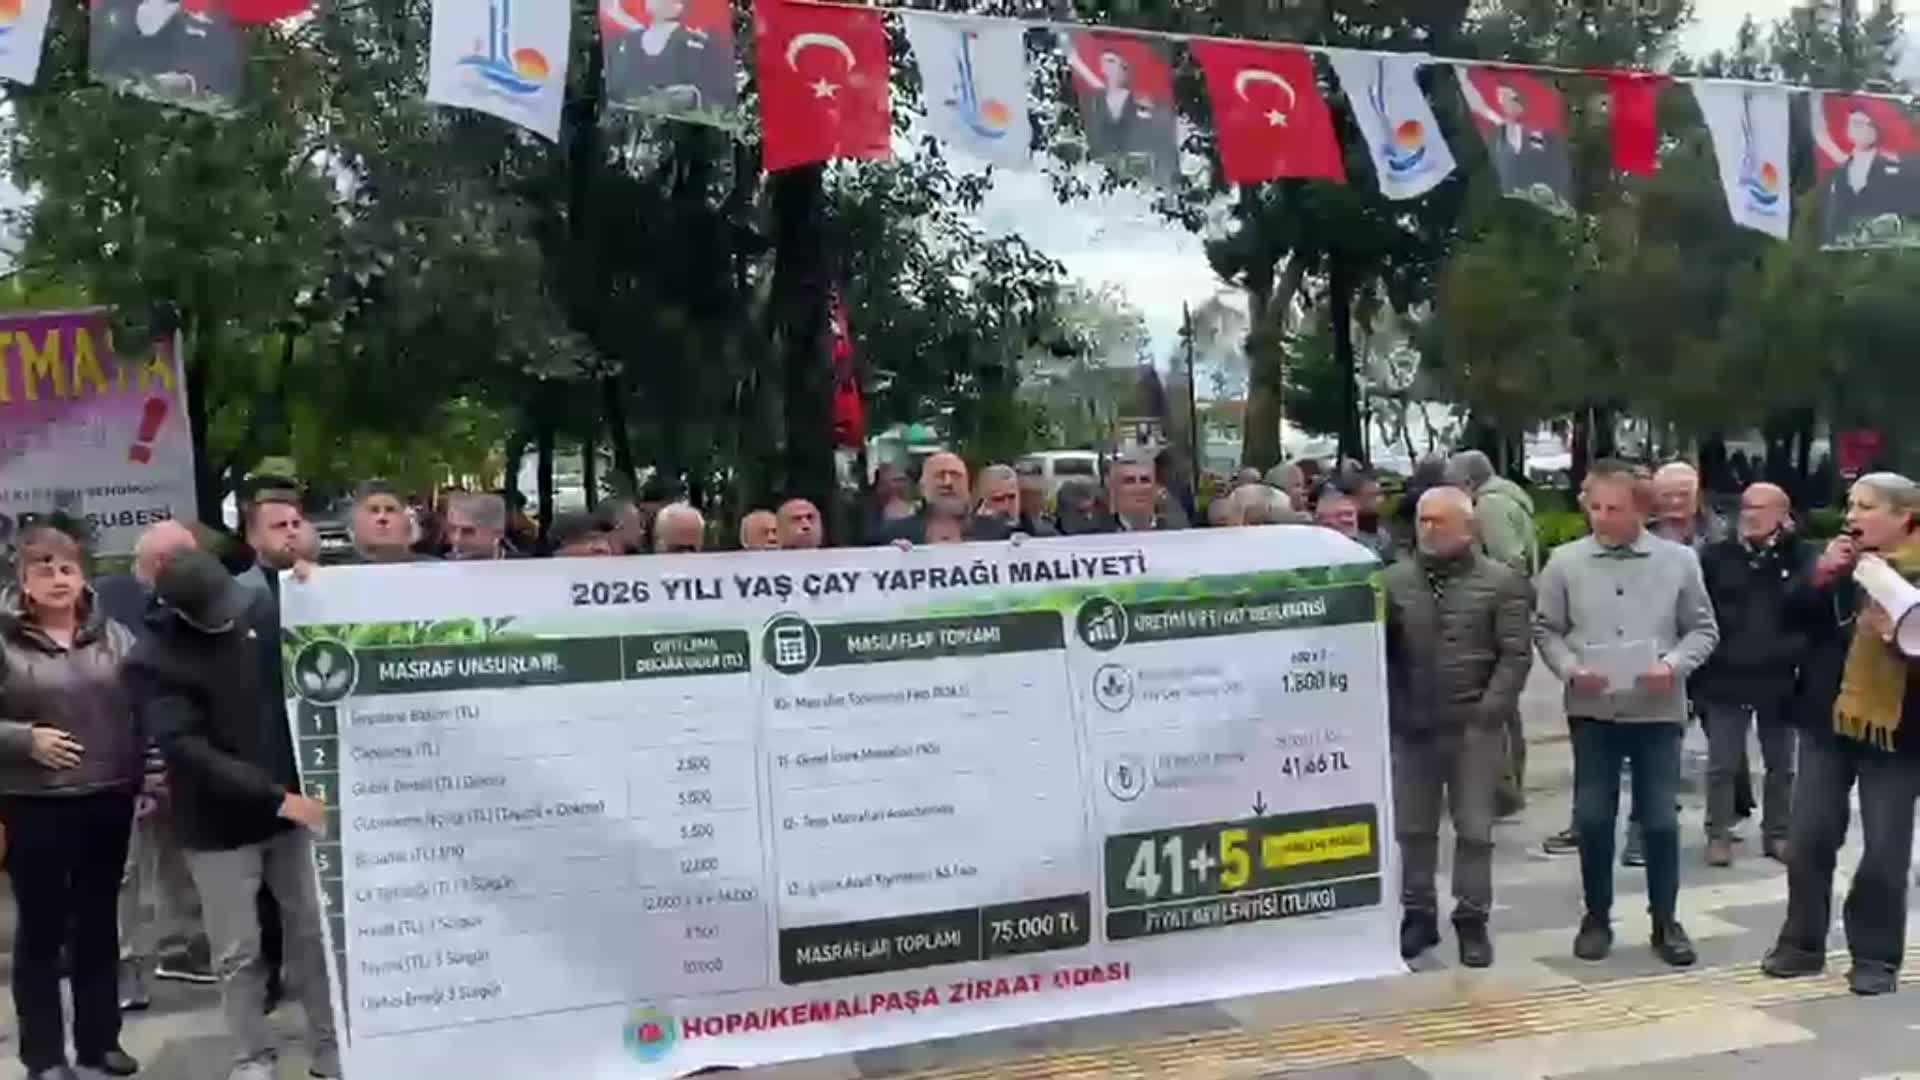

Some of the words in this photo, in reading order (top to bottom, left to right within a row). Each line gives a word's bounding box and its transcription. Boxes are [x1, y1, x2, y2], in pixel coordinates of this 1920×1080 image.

[572, 581, 650, 605] 2026
[662, 577, 721, 601] YILI
[732, 572, 793, 602] YAŞ
[873, 559, 999, 592] YAPRAĞI
[1009, 555, 1146, 583] MALİYETİ
[379, 659, 454, 682] MASRAF
[1329, 671, 1348, 692] kg
[313, 713, 323, 731] 1
[314, 747, 326, 766] 2
[1331, 751, 1351, 770] TL
[1124, 828, 1250, 897] 41+5
[991, 914, 1054, 943] 75.000
[1058, 912, 1079, 935] TL
[895, 930, 961, 955] TOPLAMI
[682, 985, 940, 1040] HOPA/KEMALPAŞA
[948, 971, 1042, 1005] ZİRAAT
